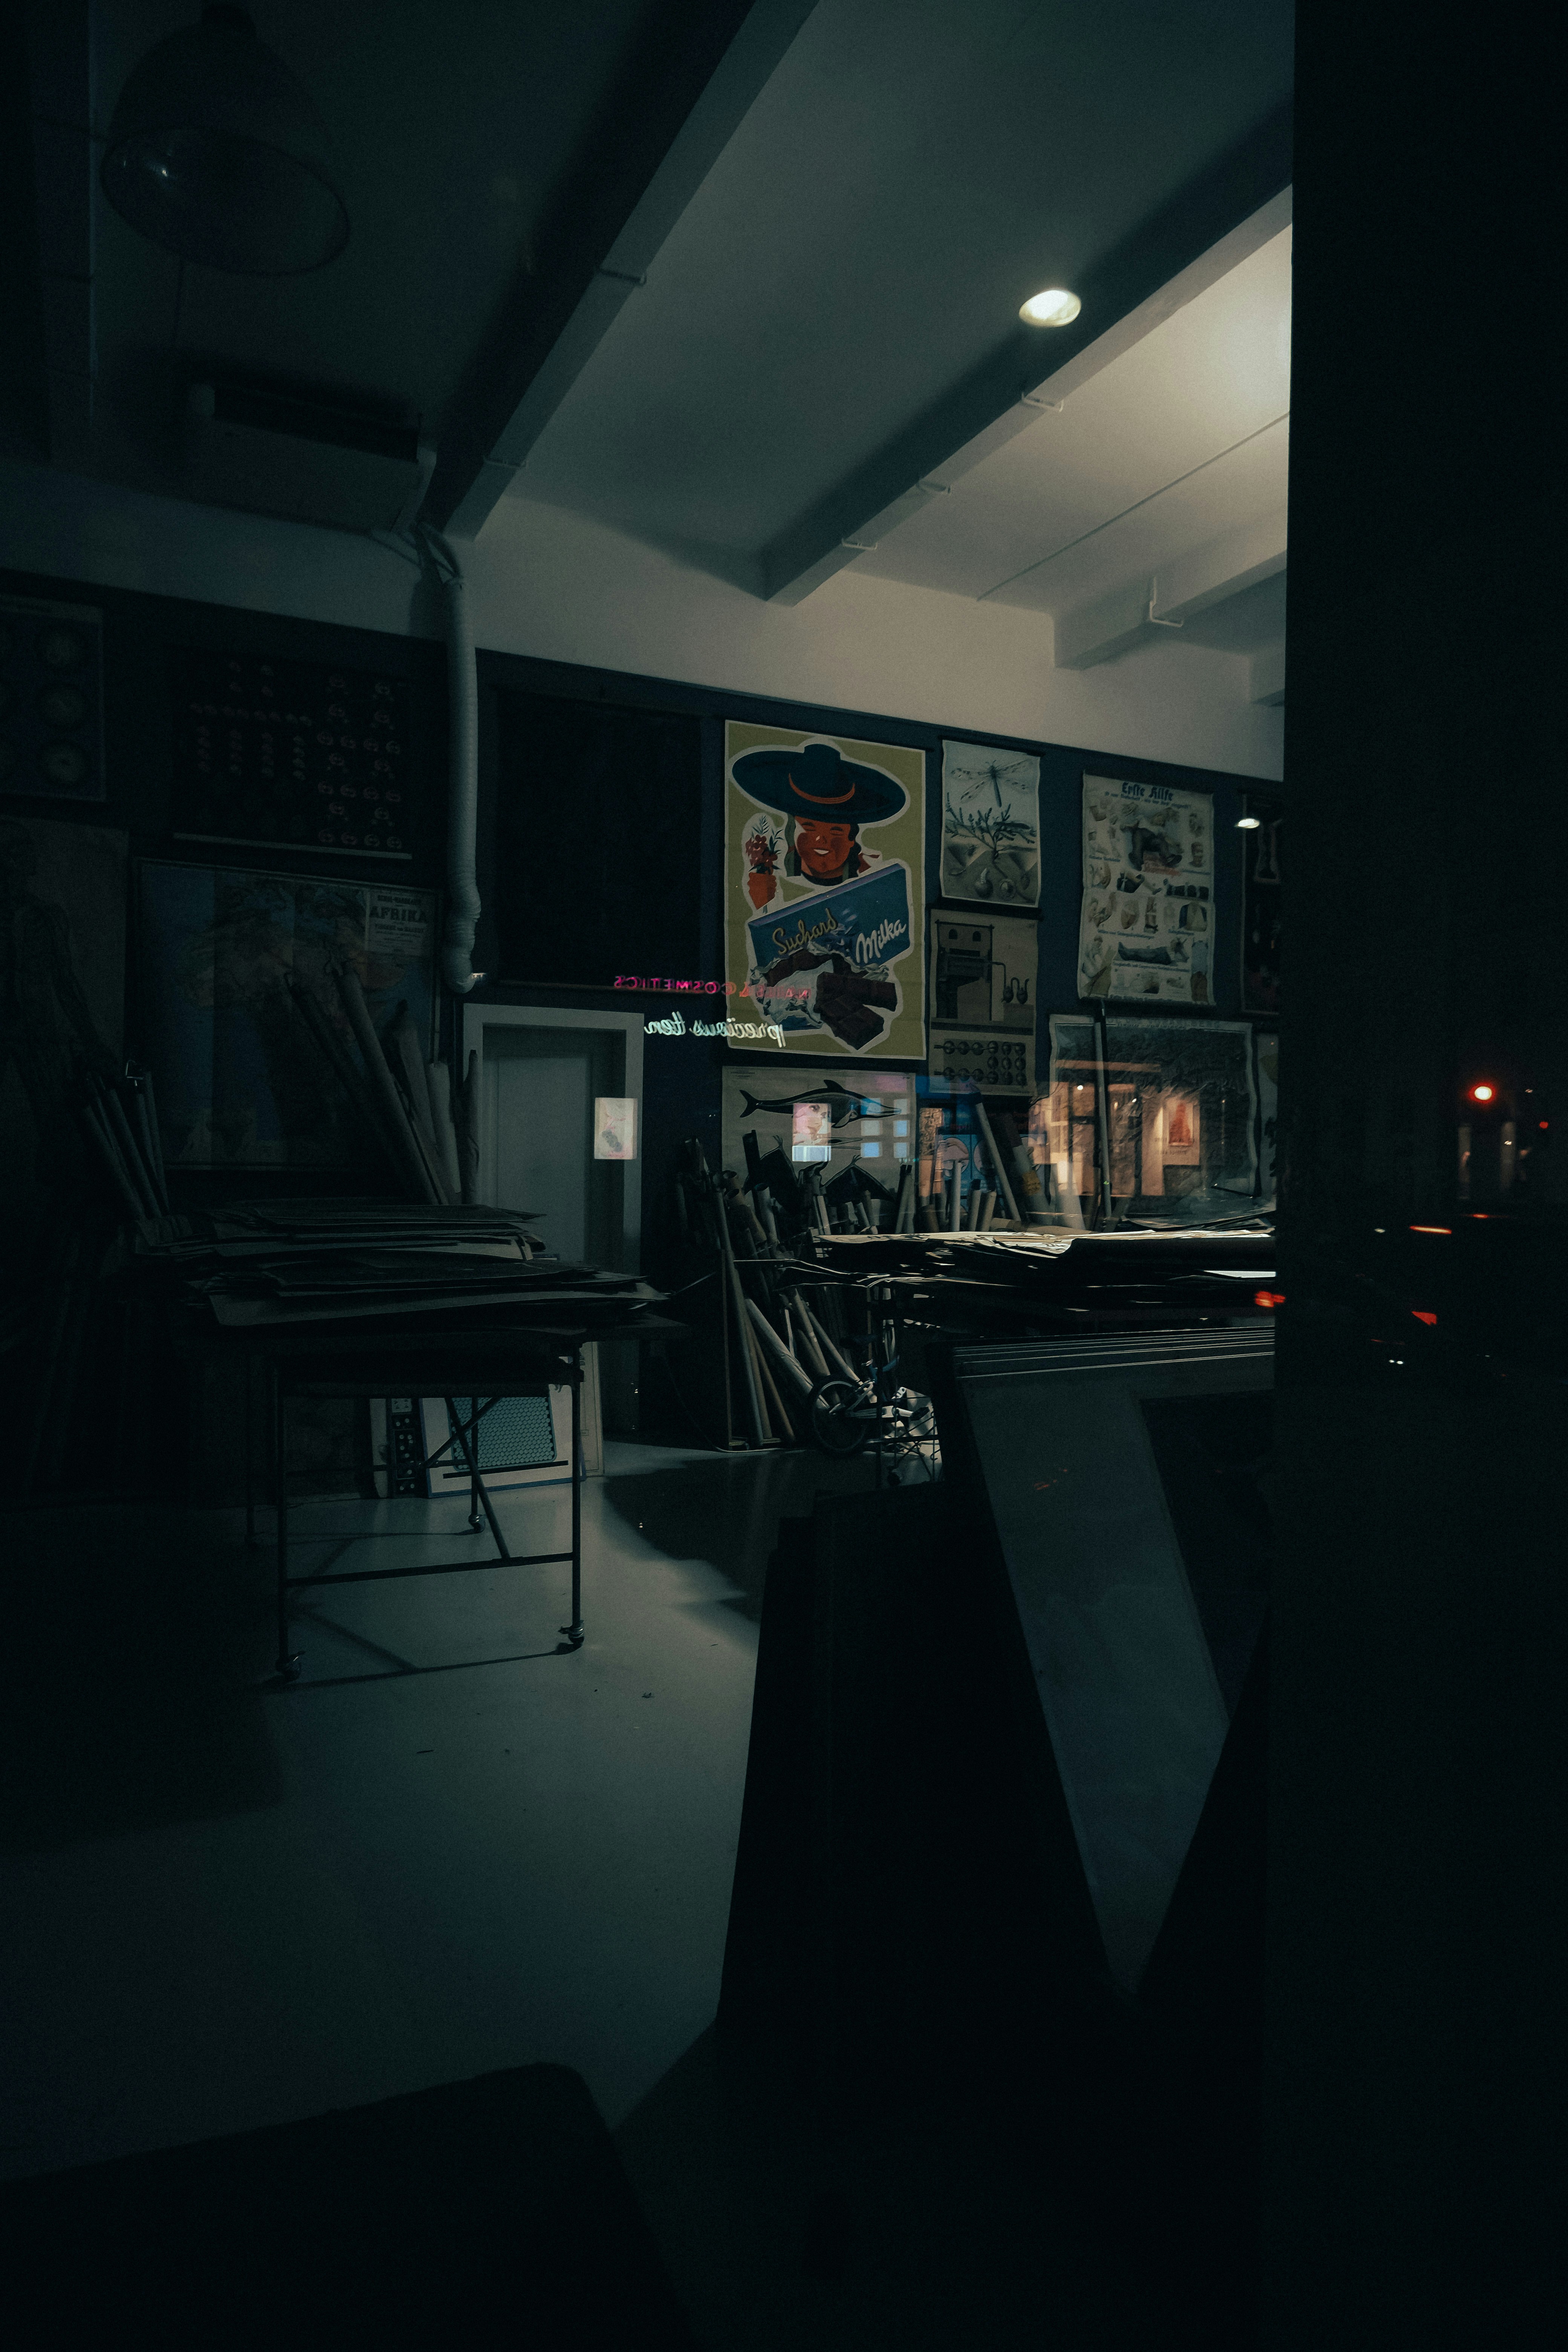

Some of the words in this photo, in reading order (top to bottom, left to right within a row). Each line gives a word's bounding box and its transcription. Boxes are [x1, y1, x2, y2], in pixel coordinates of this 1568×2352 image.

[370, 906, 427, 923] AFRIKA
[773, 909, 838, 955] Suchard
[856, 917, 906, 963] Milka
